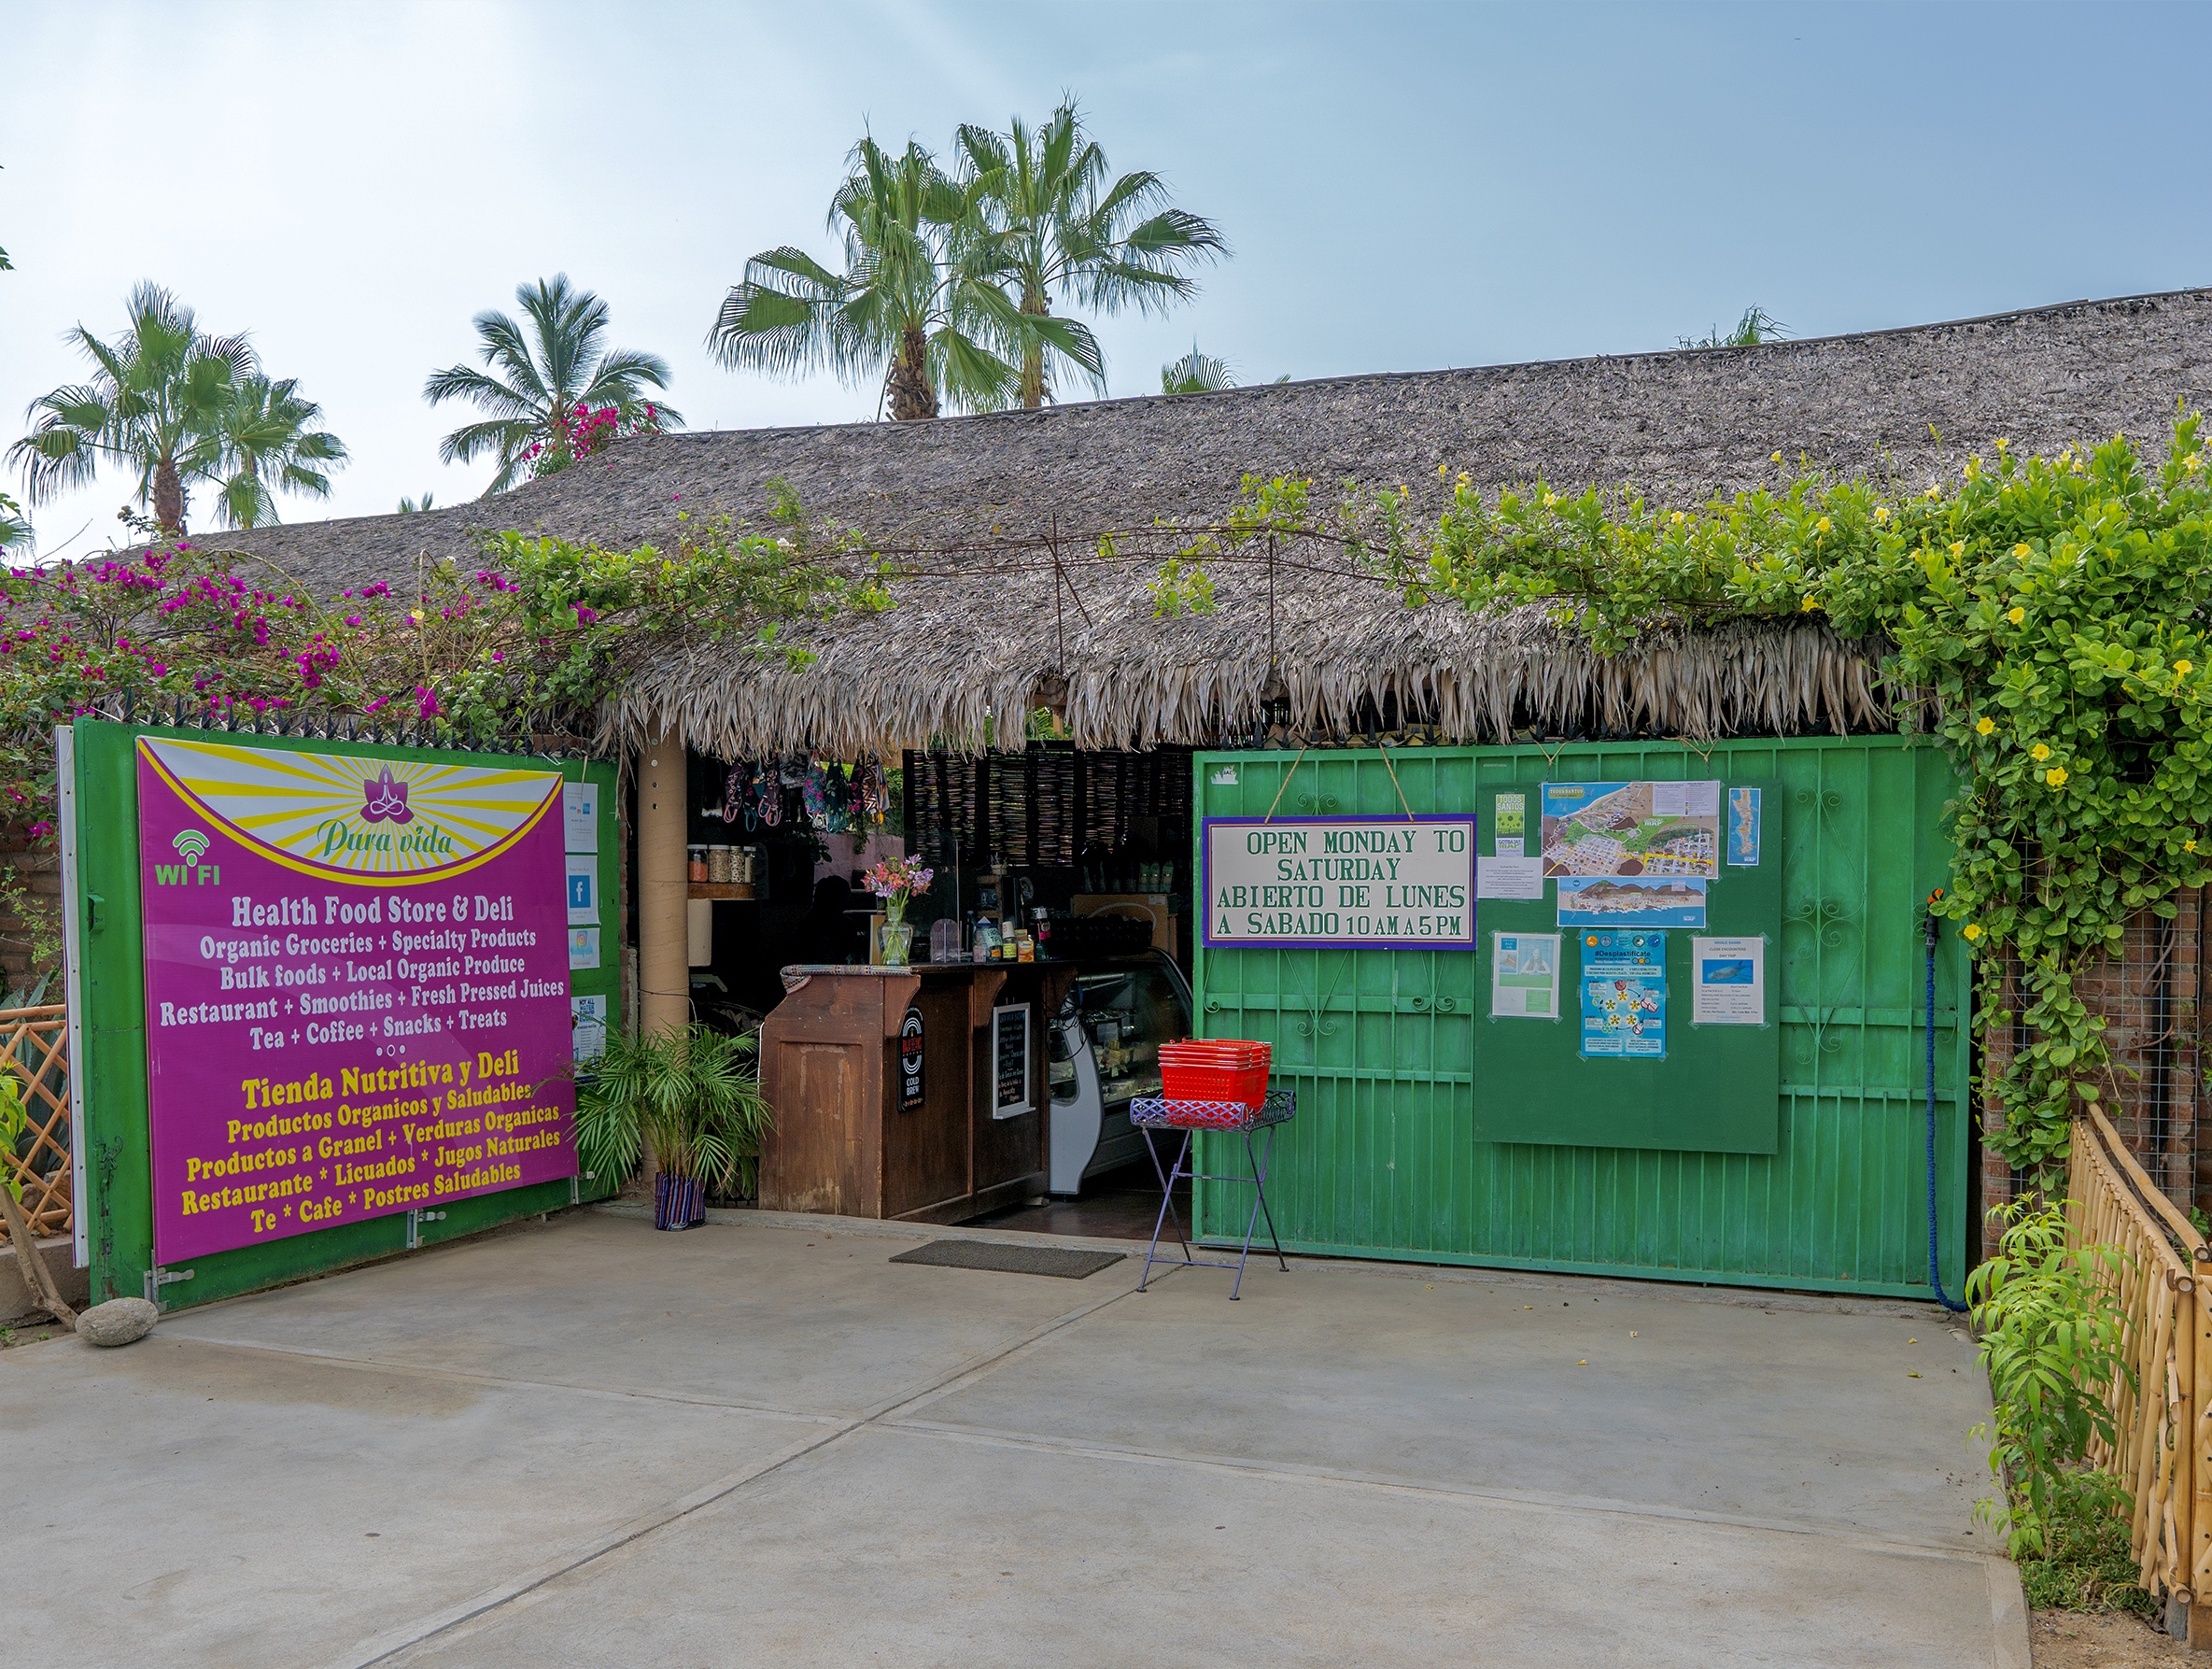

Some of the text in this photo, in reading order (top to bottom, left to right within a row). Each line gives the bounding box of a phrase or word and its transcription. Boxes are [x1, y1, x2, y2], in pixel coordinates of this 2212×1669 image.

[1497, 802, 1524, 811] SANTOS
[317, 819, 453, 856] Pura vida
[1247, 830, 1464, 855] OPEN MONDAY TO
[155, 865, 219, 885] WI FI
[1278, 858, 1401, 881] SATURDAY
[232, 897, 317, 926] Health
[325, 897, 381, 924] Food
[388, 896, 445, 923] Store
[474, 896, 514, 921] Deli
[1218, 885, 1464, 908] ABIERTO DE LUNES
[1218, 914, 1231, 934] A
[1247, 912, 1338, 934] SABADO
[200, 935, 280, 964] Organic
[286, 932, 373, 955] Groceries
[393, 929, 466, 955] Specialty
[471, 928, 535, 948] Products
[220, 966, 270, 989] Bulk
[275, 963, 326, 986] foods
[346, 959, 392, 982] Local
[398, 958, 459, 983] Organic
[464, 955, 524, 975] Produce
[161, 997, 277, 1025] Restaurant
[301, 989, 392, 1014] Smoothies
[411, 984, 456, 1006] Fresh
[460, 980, 516, 1002] Pressed
[521, 979, 563, 997] Juices
[250, 1027, 284, 1050] Tea
[307, 1021, 363, 1044] Coffee
[384, 1013, 441, 1037] Snacks
[459, 1010, 506, 1029] Treats
[242, 1050, 519, 1109] Tienda Nutritiva y Deli
[907, 1077, 919, 1086] COLD
[907, 1085, 920, 1096] BREW
[227, 1082, 531, 1143] Productos Organicos y Saludables
[187, 1148, 296, 1181] Productos
[303, 1146, 313, 1162] a
[318, 1129, 382, 1158] Granel
[402, 1119, 480, 1146] Verduras
[485, 1105, 558, 1132] Organicas
[182, 1174, 312, 1215] Restaurante
[335, 1155, 415, 1185] Licuados
[435, 1145, 482, 1167] Jugos
[486, 1129, 559, 1157] Naturales
[251, 1209, 275, 1232] Te
[300, 1196, 342, 1222] Cafe
[363, 1182, 429, 1209] Postres
[434, 1163, 520, 1195] Saludables
